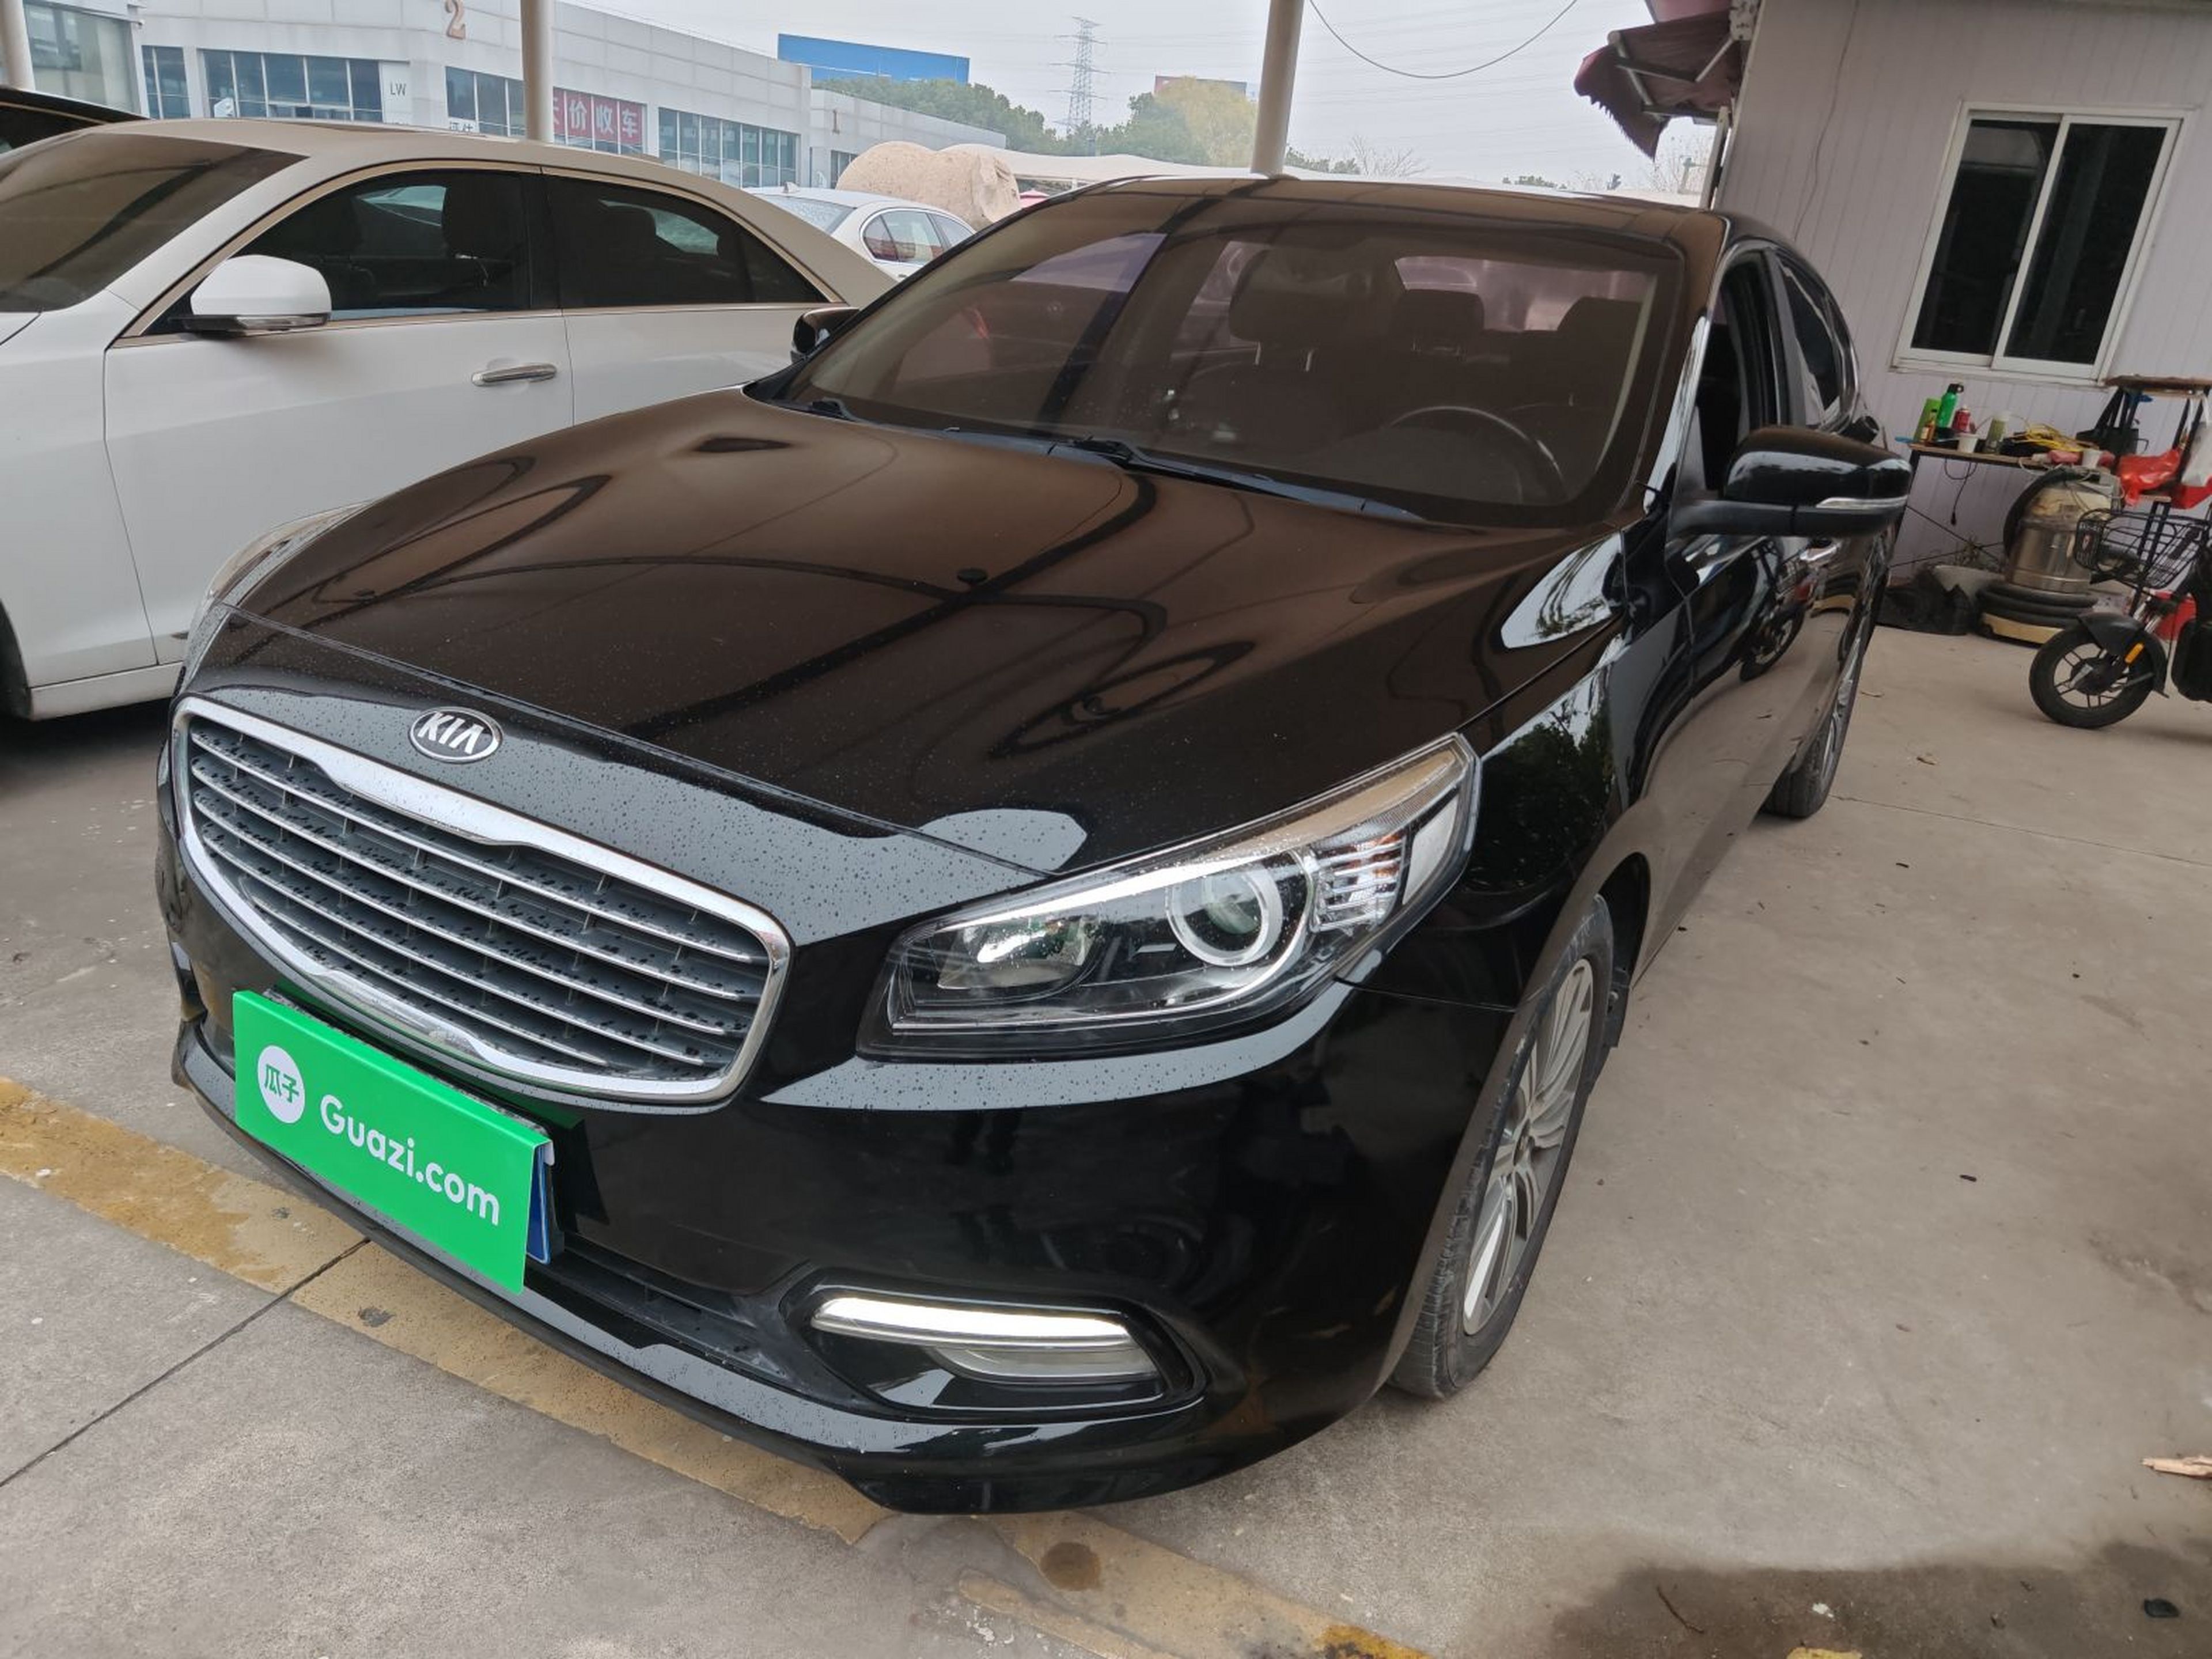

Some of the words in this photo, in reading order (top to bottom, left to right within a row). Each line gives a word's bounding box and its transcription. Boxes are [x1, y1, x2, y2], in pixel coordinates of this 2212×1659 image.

[445, 0, 465, 40] 2
[417, 711, 484, 755] KIA
[264, 1063, 300, 1104] 瓜子
[320, 1094, 499, 1226] Guazi.com
